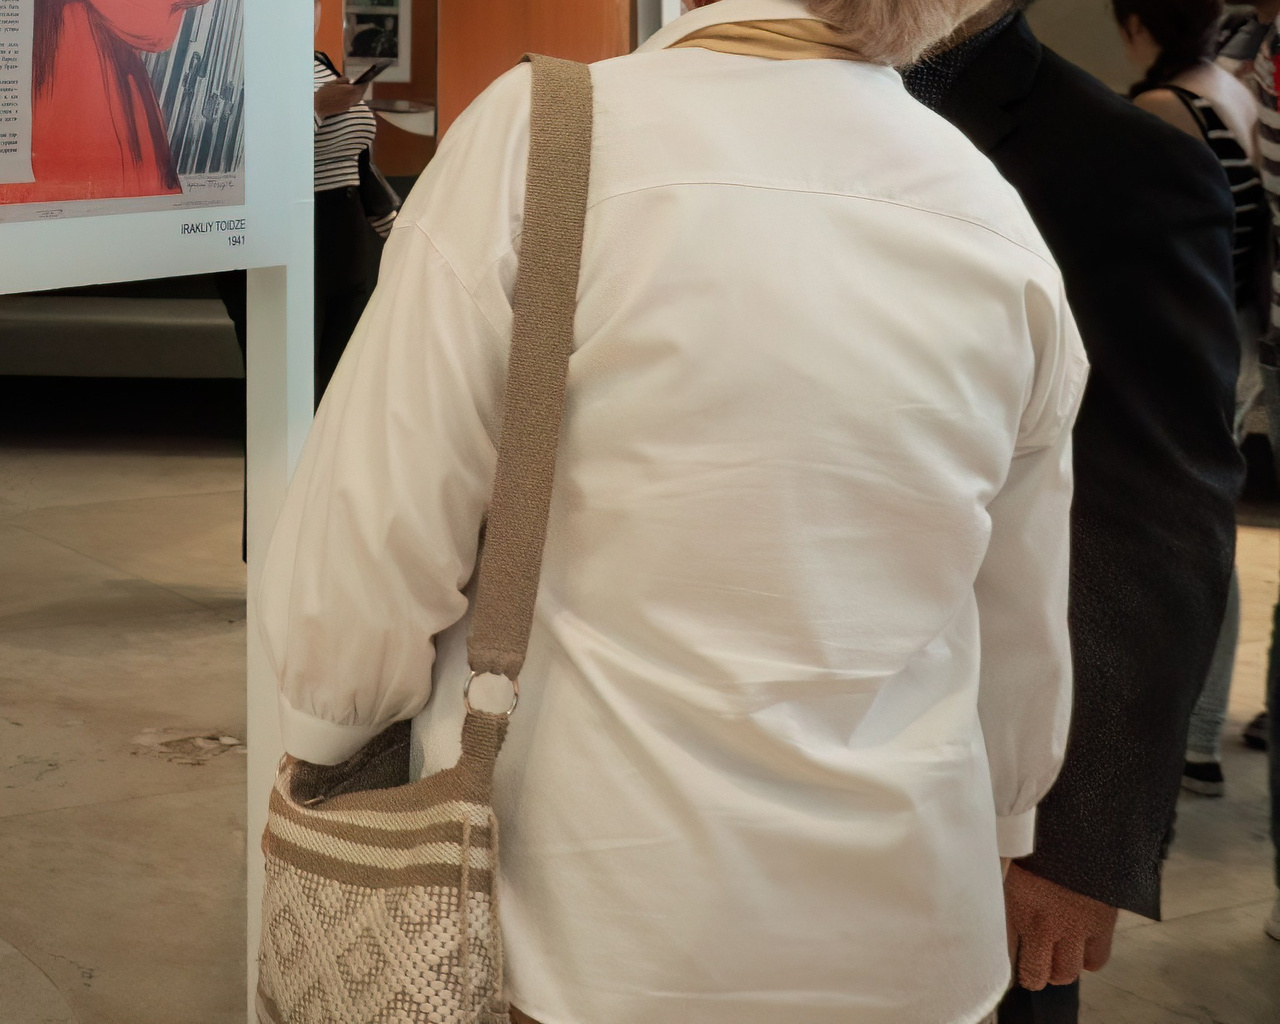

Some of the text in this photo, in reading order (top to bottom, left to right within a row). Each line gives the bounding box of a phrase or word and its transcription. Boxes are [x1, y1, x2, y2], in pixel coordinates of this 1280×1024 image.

[181, 219, 246, 235] IRAKLIY TOIDZE
[228, 235, 246, 246] 1941
